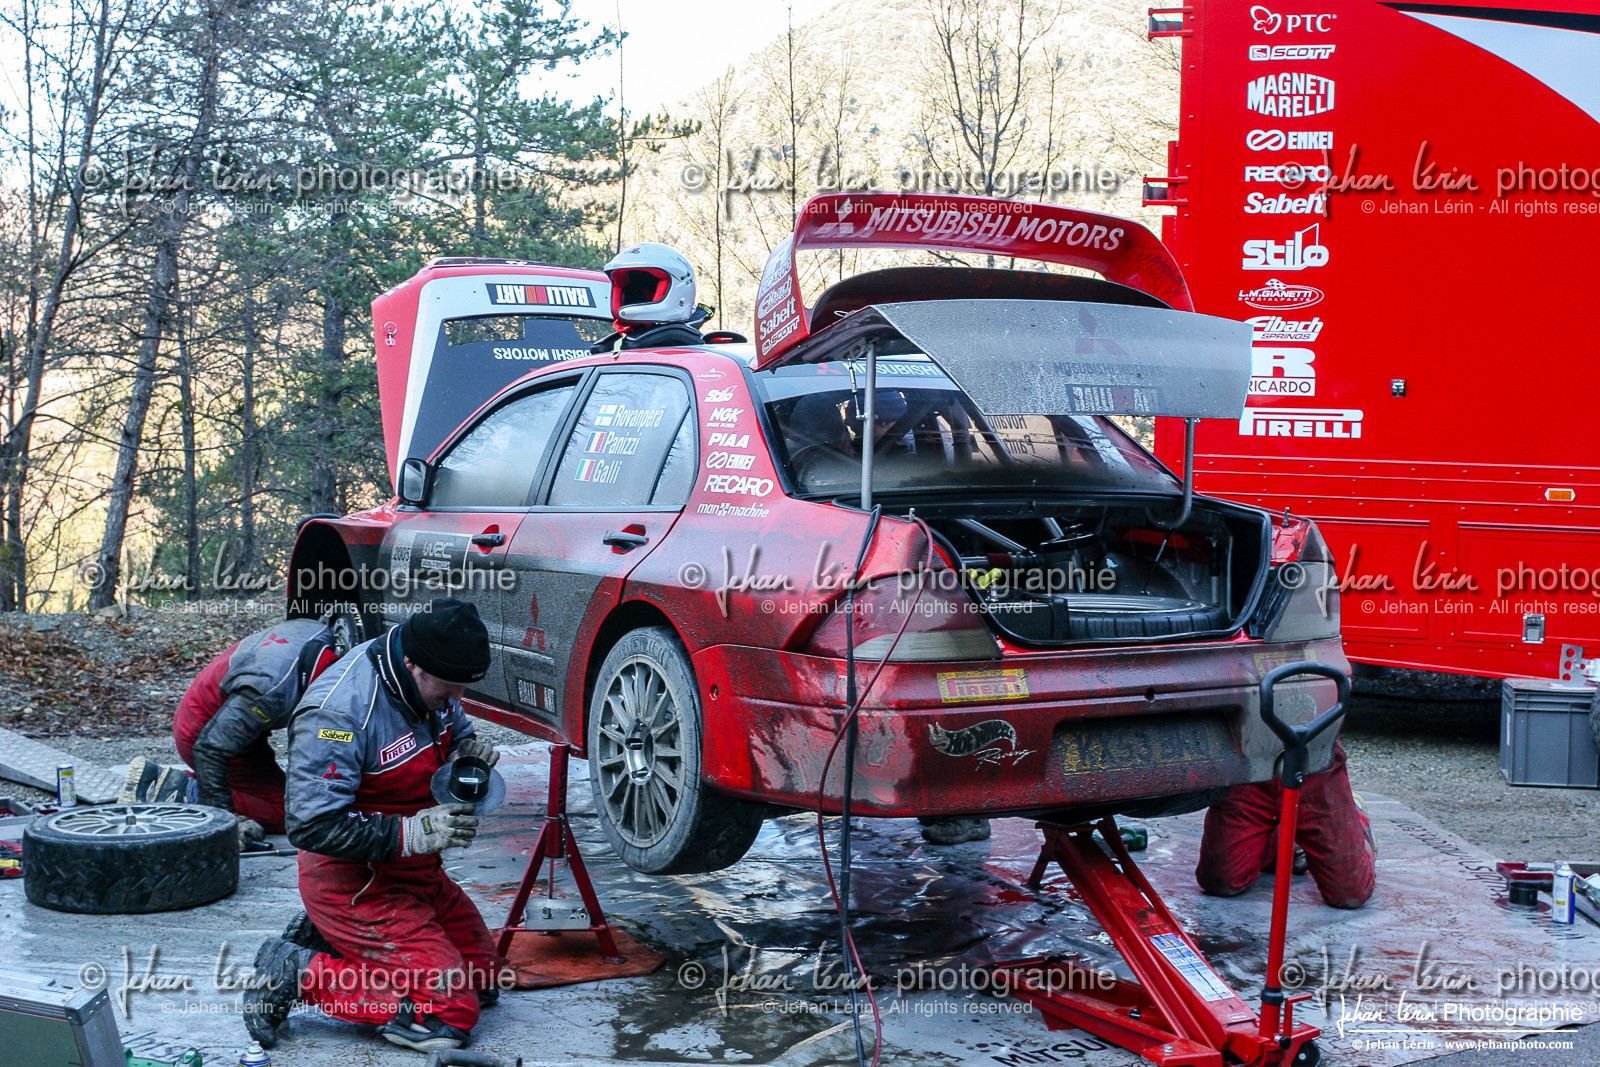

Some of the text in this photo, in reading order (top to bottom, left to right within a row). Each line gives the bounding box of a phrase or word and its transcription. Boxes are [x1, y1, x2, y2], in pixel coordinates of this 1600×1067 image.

[1286, 14, 1332, 33] PTC
[1270, 44, 1336, 60] SCOTT
[1247, 72, 1335, 96] MAGNETI
[1247, 95, 1335, 118] MARELLI
[1287, 131, 1334, 149] ENKEI
[1244, 165, 1331, 182] RECARO
[1243, 192, 1329, 214] Sabelt
[864, 207, 1125, 251] MITSUBISHI MOTORS
[1242, 223, 1330, 270] Stilo
[495, 284, 590, 307] RALLI ART
[759, 296, 796, 341] Sabelt
[493, 347, 550, 361] MOTORS
[842, 362, 943, 376] MISUBISHI
[704, 384, 738, 403] Stilo
[611, 404, 668, 433] Rovanperä
[709, 407, 745, 423] NGK
[1239, 406, 1364, 439] PIRELLI
[601, 431, 643, 456] Panizzi
[707, 432, 751, 449] PIAA
[592, 459, 623, 484] Galli
[725, 453, 757, 471] ENKEI
[703, 474, 775, 497] RECARO
[946, 674, 1021, 698] PIRELLI
[320, 730, 351, 742] Sabelt
[381, 732, 418, 766] PIRELLI
